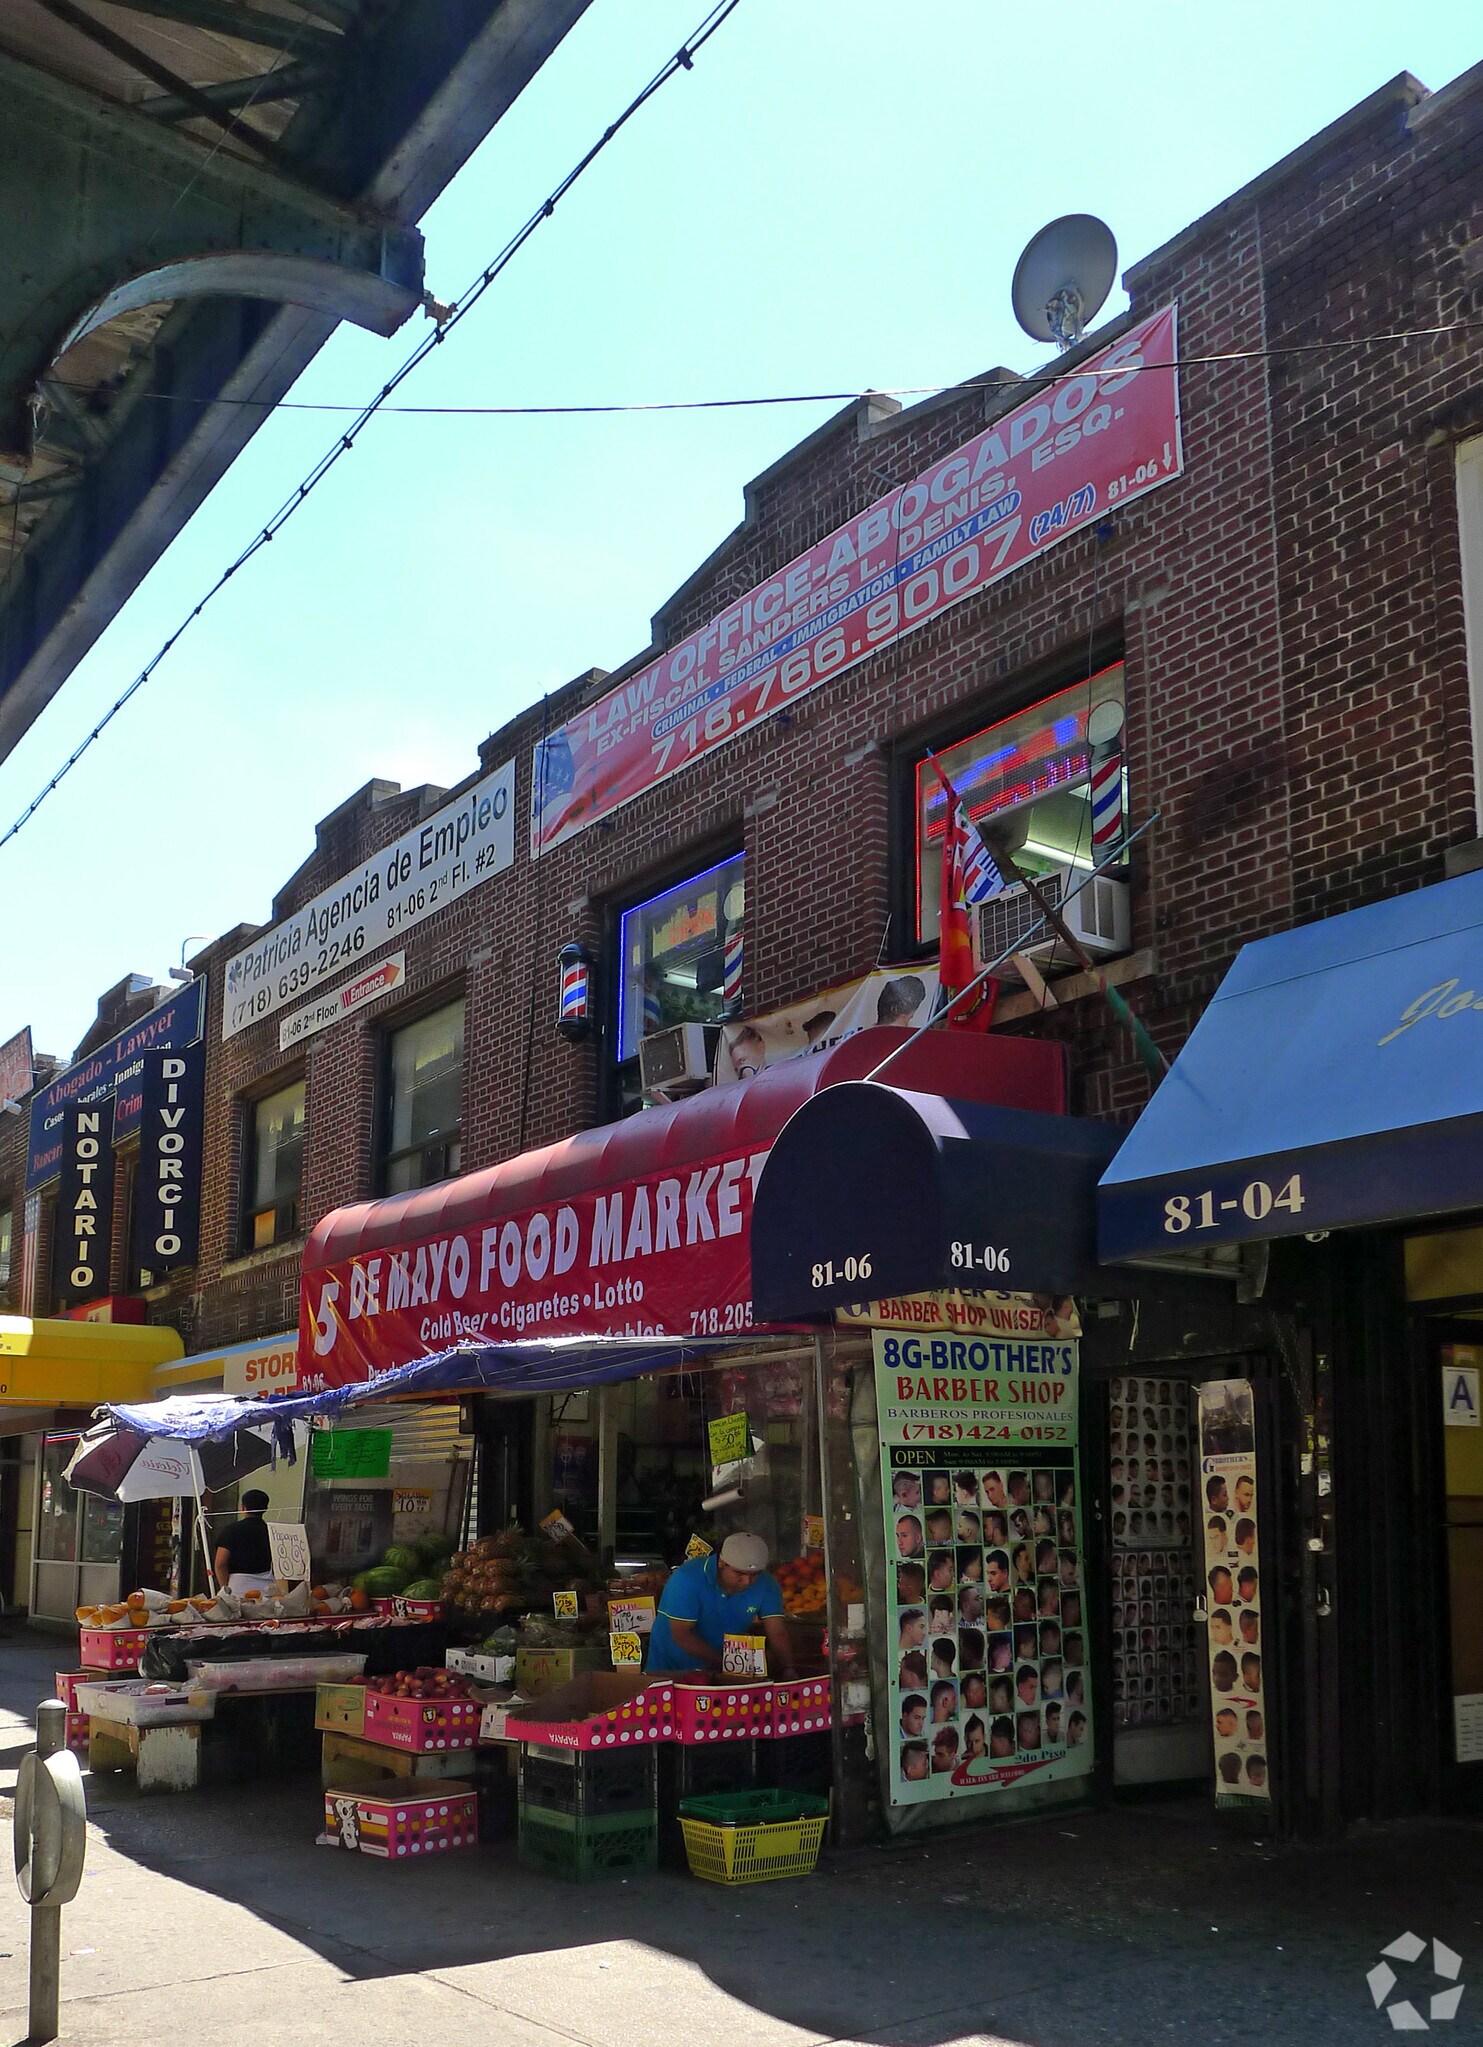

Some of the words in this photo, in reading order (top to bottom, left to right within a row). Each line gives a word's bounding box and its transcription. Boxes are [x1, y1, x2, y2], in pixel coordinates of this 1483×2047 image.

[1107, 459, 1158, 499] 81-06
[1029, 482, 1097, 545] (24/7)
[588, 667, 661, 742] LAW
[669, 341, 1145, 682] OFFICE-ABOGADOS
[597, 668, 711, 756] EX-FISCAL
[719, 573, 850, 673] SANDERS
[860, 559, 887, 583] L.
[899, 471, 1017, 557] DENIS,
[1031, 404, 1125, 472] ESQ.
[654, 691, 711, 737] CRIMINAL
[724, 649, 778, 692] FEDERAL
[792, 570, 896, 647] IMMIGRATION
[912, 518, 977, 572] FAMILY
[977, 493, 1018, 527] LAW
[652, 515, 1022, 775] 718.766.9007
[243, 920, 301, 988] Patricia
[305, 870, 380, 946] Agencia
[386, 848, 411, 891] de
[419, 787, 508, 871] Empleo
[386, 895, 425, 929] 81-06
[429, 872, 448, 903] 2nd
[452, 862, 470, 888] Fl.
[475, 843, 495, 875] #2
[232, 985, 272, 1029] (718)
[278, 925, 365, 999] 639-2246
[350, 973, 385, 1003] Entrance
[317, 1001, 339, 1023] Floor
[47, 1061, 103, 1108] Abogado
[116, 1009, 175, 1063] Lawyer
[116, 1094, 142, 1120] Crim
[155, 1059, 186, 1256] DIVORCIO
[70, 1112, 99, 1288] NOTARIO
[1164, 1173, 1305, 1234] 81-04
[811, 1253, 872, 1288] 81-06
[950, 1241, 1011, 1273] 81-06
[314, 1282, 340, 1356] 5
[349, 1258, 382, 1320] DE
[386, 1235, 471, 1312] MAYO
[480, 1207, 580, 1293] FOOD
[420, 1315, 451, 1342] Cold
[453, 1310, 489, 1336] Beer
[500, 1291, 579, 1331] Cigaretes
[593, 1276, 644, 1310] Lotto
[690, 1301, 754, 1336] 718.205
[878, 1299, 943, 1323] BARBER
[945, 1303, 987, 1327] SHOP
[991, 1308, 1045, 1331] UNISEX
[245, 1351, 297, 1382] STOR
[883, 1337, 1072, 1375] 8G-BROTHER'S
[896, 1376, 1000, 1403] BARBER
[1008, 1379, 1065, 1404] SHOP
[1449, 1375, 1475, 1410] A
[888, 1408, 968, 1420] BARBEROS
[972, 1409, 1073, 1422] PROFESIONALES
[894, 1450, 936, 1465] OPEN
[271, 1527, 299, 1548] Papaya
[549, 1733, 579, 1746] PAPAYA
[1041, 1750, 1067, 1760] Piso
